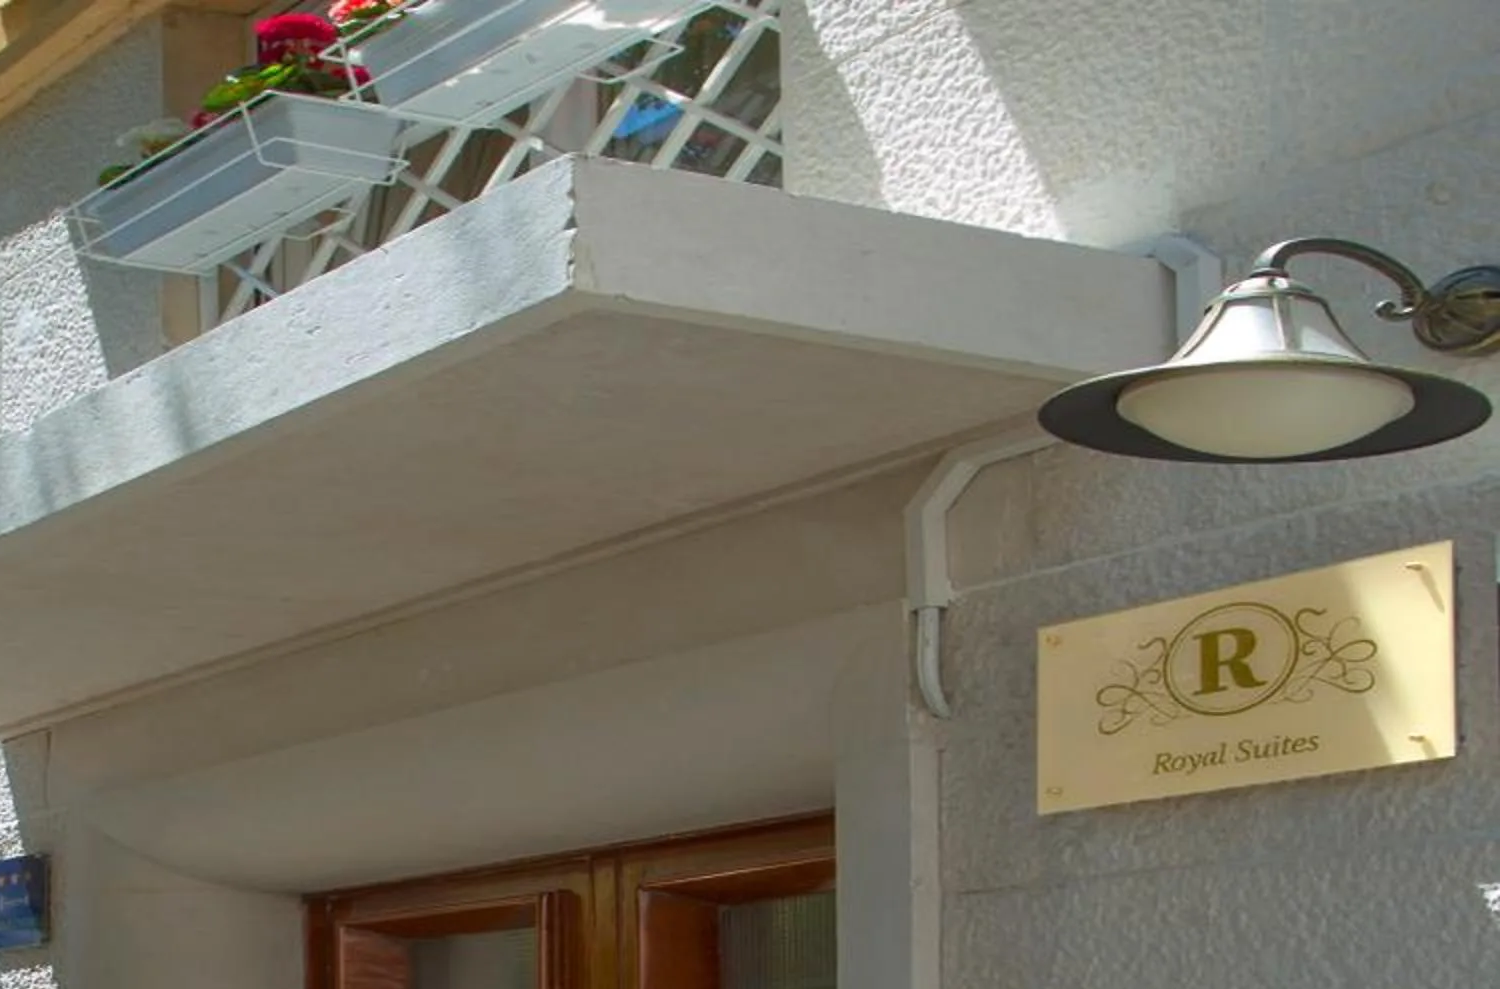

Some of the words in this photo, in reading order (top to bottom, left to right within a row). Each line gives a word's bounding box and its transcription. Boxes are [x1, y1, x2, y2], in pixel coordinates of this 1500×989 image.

[1192, 627, 1267, 695] R
[1152, 742, 1227, 775] Royal
[1234, 734, 1320, 762] Suites
